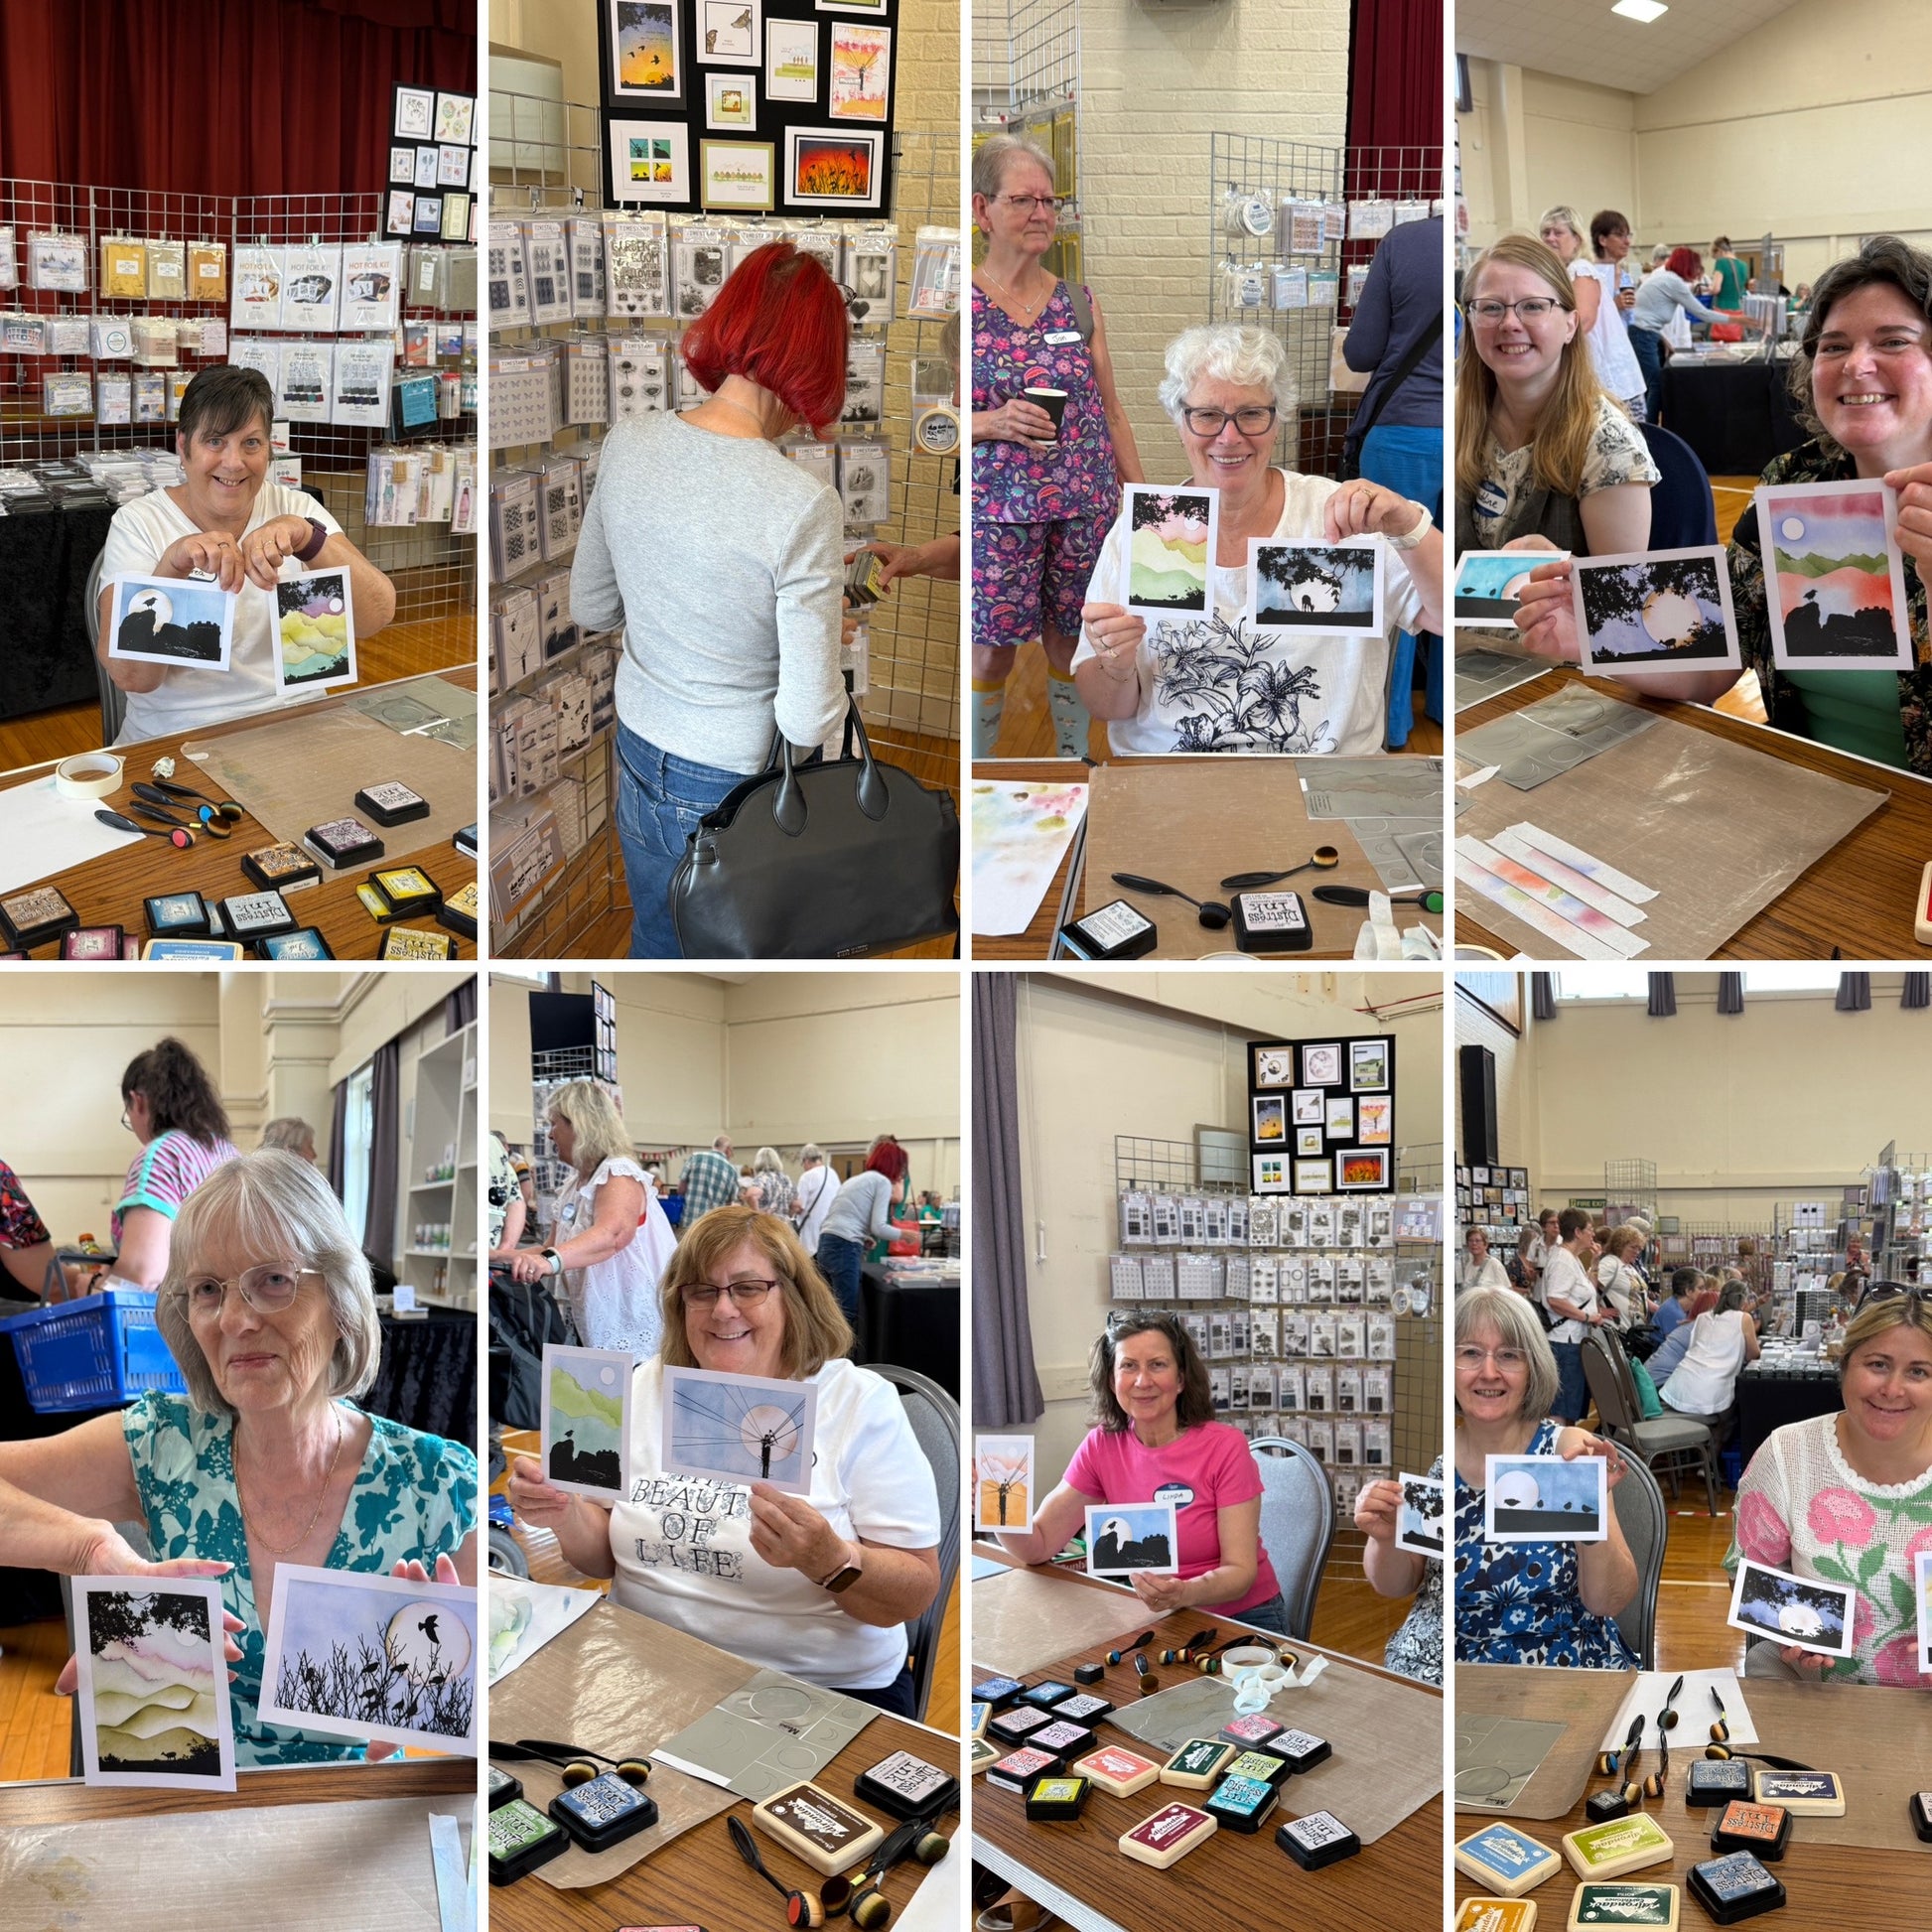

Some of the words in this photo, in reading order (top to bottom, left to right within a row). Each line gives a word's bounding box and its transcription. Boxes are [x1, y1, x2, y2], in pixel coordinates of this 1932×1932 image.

[379, 260, 390, 269] KIT
[239, 899, 273, 911] Ink
[1249, 901, 1289, 912] Ink
[235, 906, 286, 922] Distress
[1247, 909, 1301, 923] Distress
[631, 1479, 748, 1516] BEAUT
[662, 1512, 713, 1544] OF
[636, 1538, 737, 1579] LIFE
[1043, 1726, 1071, 1741] Ink
[1048, 1724, 1082, 1738] Distress
[1276, 1738, 1310, 1754] Distress
[1284, 1733, 1312, 1747] Ink
[1237, 1761, 1272, 1775] Ink
[1240, 1754, 1278, 1769] Distress
[885, 1761, 922, 1783] Ink
[898, 1765, 943, 1793] Distress
[1224, 1778, 1265, 1797] Distress
[574, 1788, 618, 1821] Distress
[594, 1784, 626, 1809] Ink
[1222, 1788, 1257, 1805] Ink
[500, 1811, 533, 1838] Ink
[1735, 1810, 1770, 1823] Ink
[488, 1818, 525, 1850] Distres
[1296, 1820, 1328, 1847] Distress
[1309, 1817, 1335, 1839] Ink
[1726, 1817, 1775, 1835] Distress
[1589, 1829, 1648, 1852] Adirondack
[1712, 1863, 1755, 1880] Ink
[1715, 1867, 1768, 1892] Distress
[1588, 1899, 1660, 1909] Adirondack
